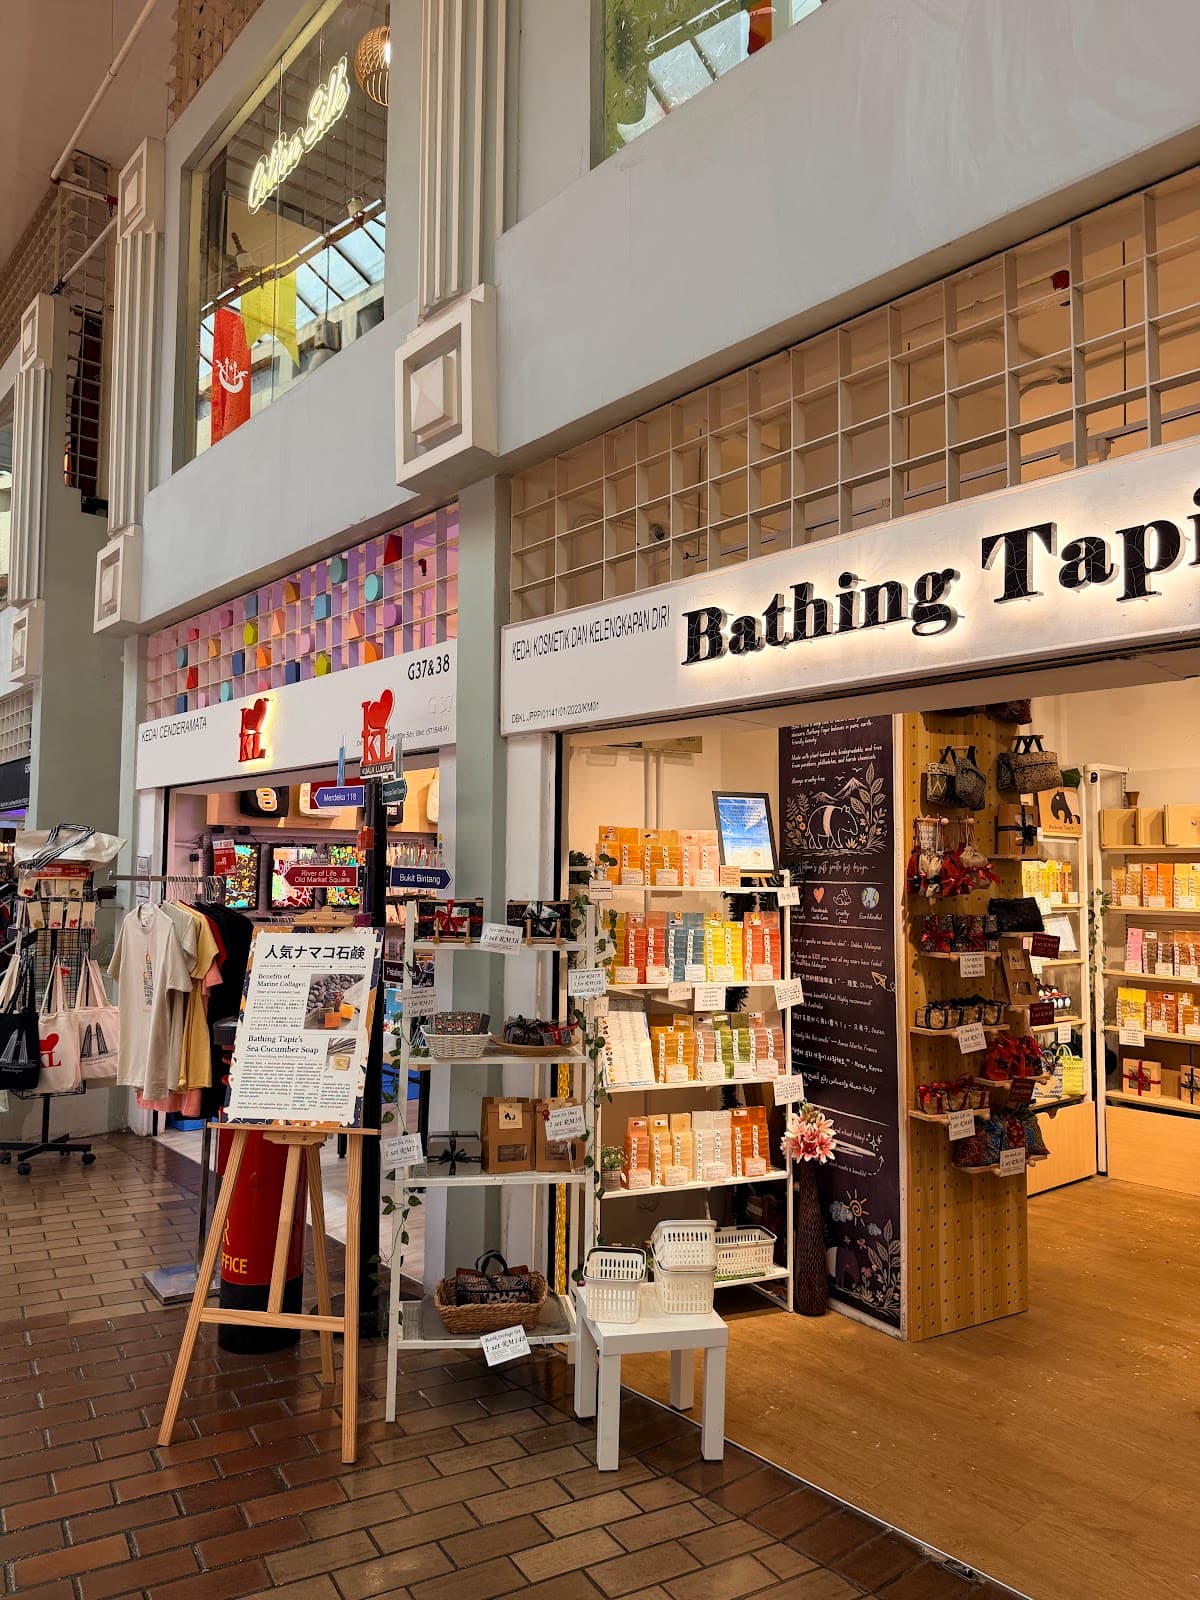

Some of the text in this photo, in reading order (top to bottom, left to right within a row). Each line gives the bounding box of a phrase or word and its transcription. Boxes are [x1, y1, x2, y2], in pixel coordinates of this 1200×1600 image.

[681, 565, 961, 666] Bathing
[512, 605, 670, 661] KEDAI KOSMETIK DAN KELENGKAPAN DIRI
[407, 653, 450, 681] G37&38
[141, 716, 208, 743] KEDAI CENDERAMATA
[361, 728, 394, 767] KL
[375, 763, 393, 774] LUMPUR
[323, 792, 357, 802] Merdeka 118
[326, 869, 337, 877] Life
[399, 873, 441, 884] Bukit Bintang
[328, 876, 351, 884] Square
[265, 944, 365, 960] 人気ナマコ石鹸
[280, 981, 306, 989] Collagen
[248, 1035, 304, 1044] Bathing Tapir's
[260, 1045, 300, 1053] Cucumber
[300, 1046, 319, 1055] Soap
[221, 1252, 248, 1275] FFICE
